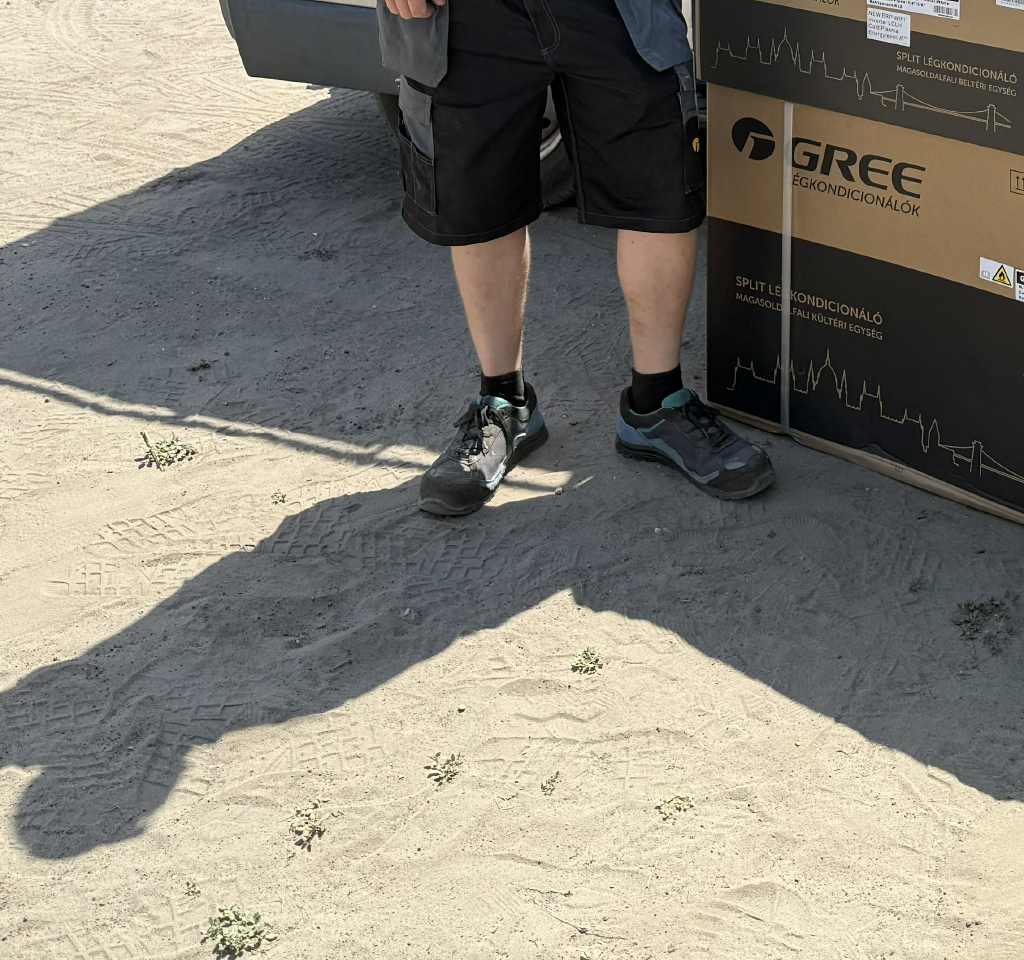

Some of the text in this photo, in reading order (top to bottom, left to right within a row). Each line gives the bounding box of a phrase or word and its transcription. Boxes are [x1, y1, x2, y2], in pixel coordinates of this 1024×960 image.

[896, 51, 1018, 84] SPLIT LÉGKONDICIONÁLÓ
[896, 65, 1017, 97] MAGASOLDALFALI BELTÉRI EGYSÉG
[792, 136, 927, 199] GREE
[791, 171, 921, 217] ÉGKONDICIONÁLÓK
[735, 275, 884, 326] SPLIT LÉKONDICIONÁLÓ
[811, 313, 848, 330] KÜLTÉRI
[849, 324, 883, 341] EGYSÉG
